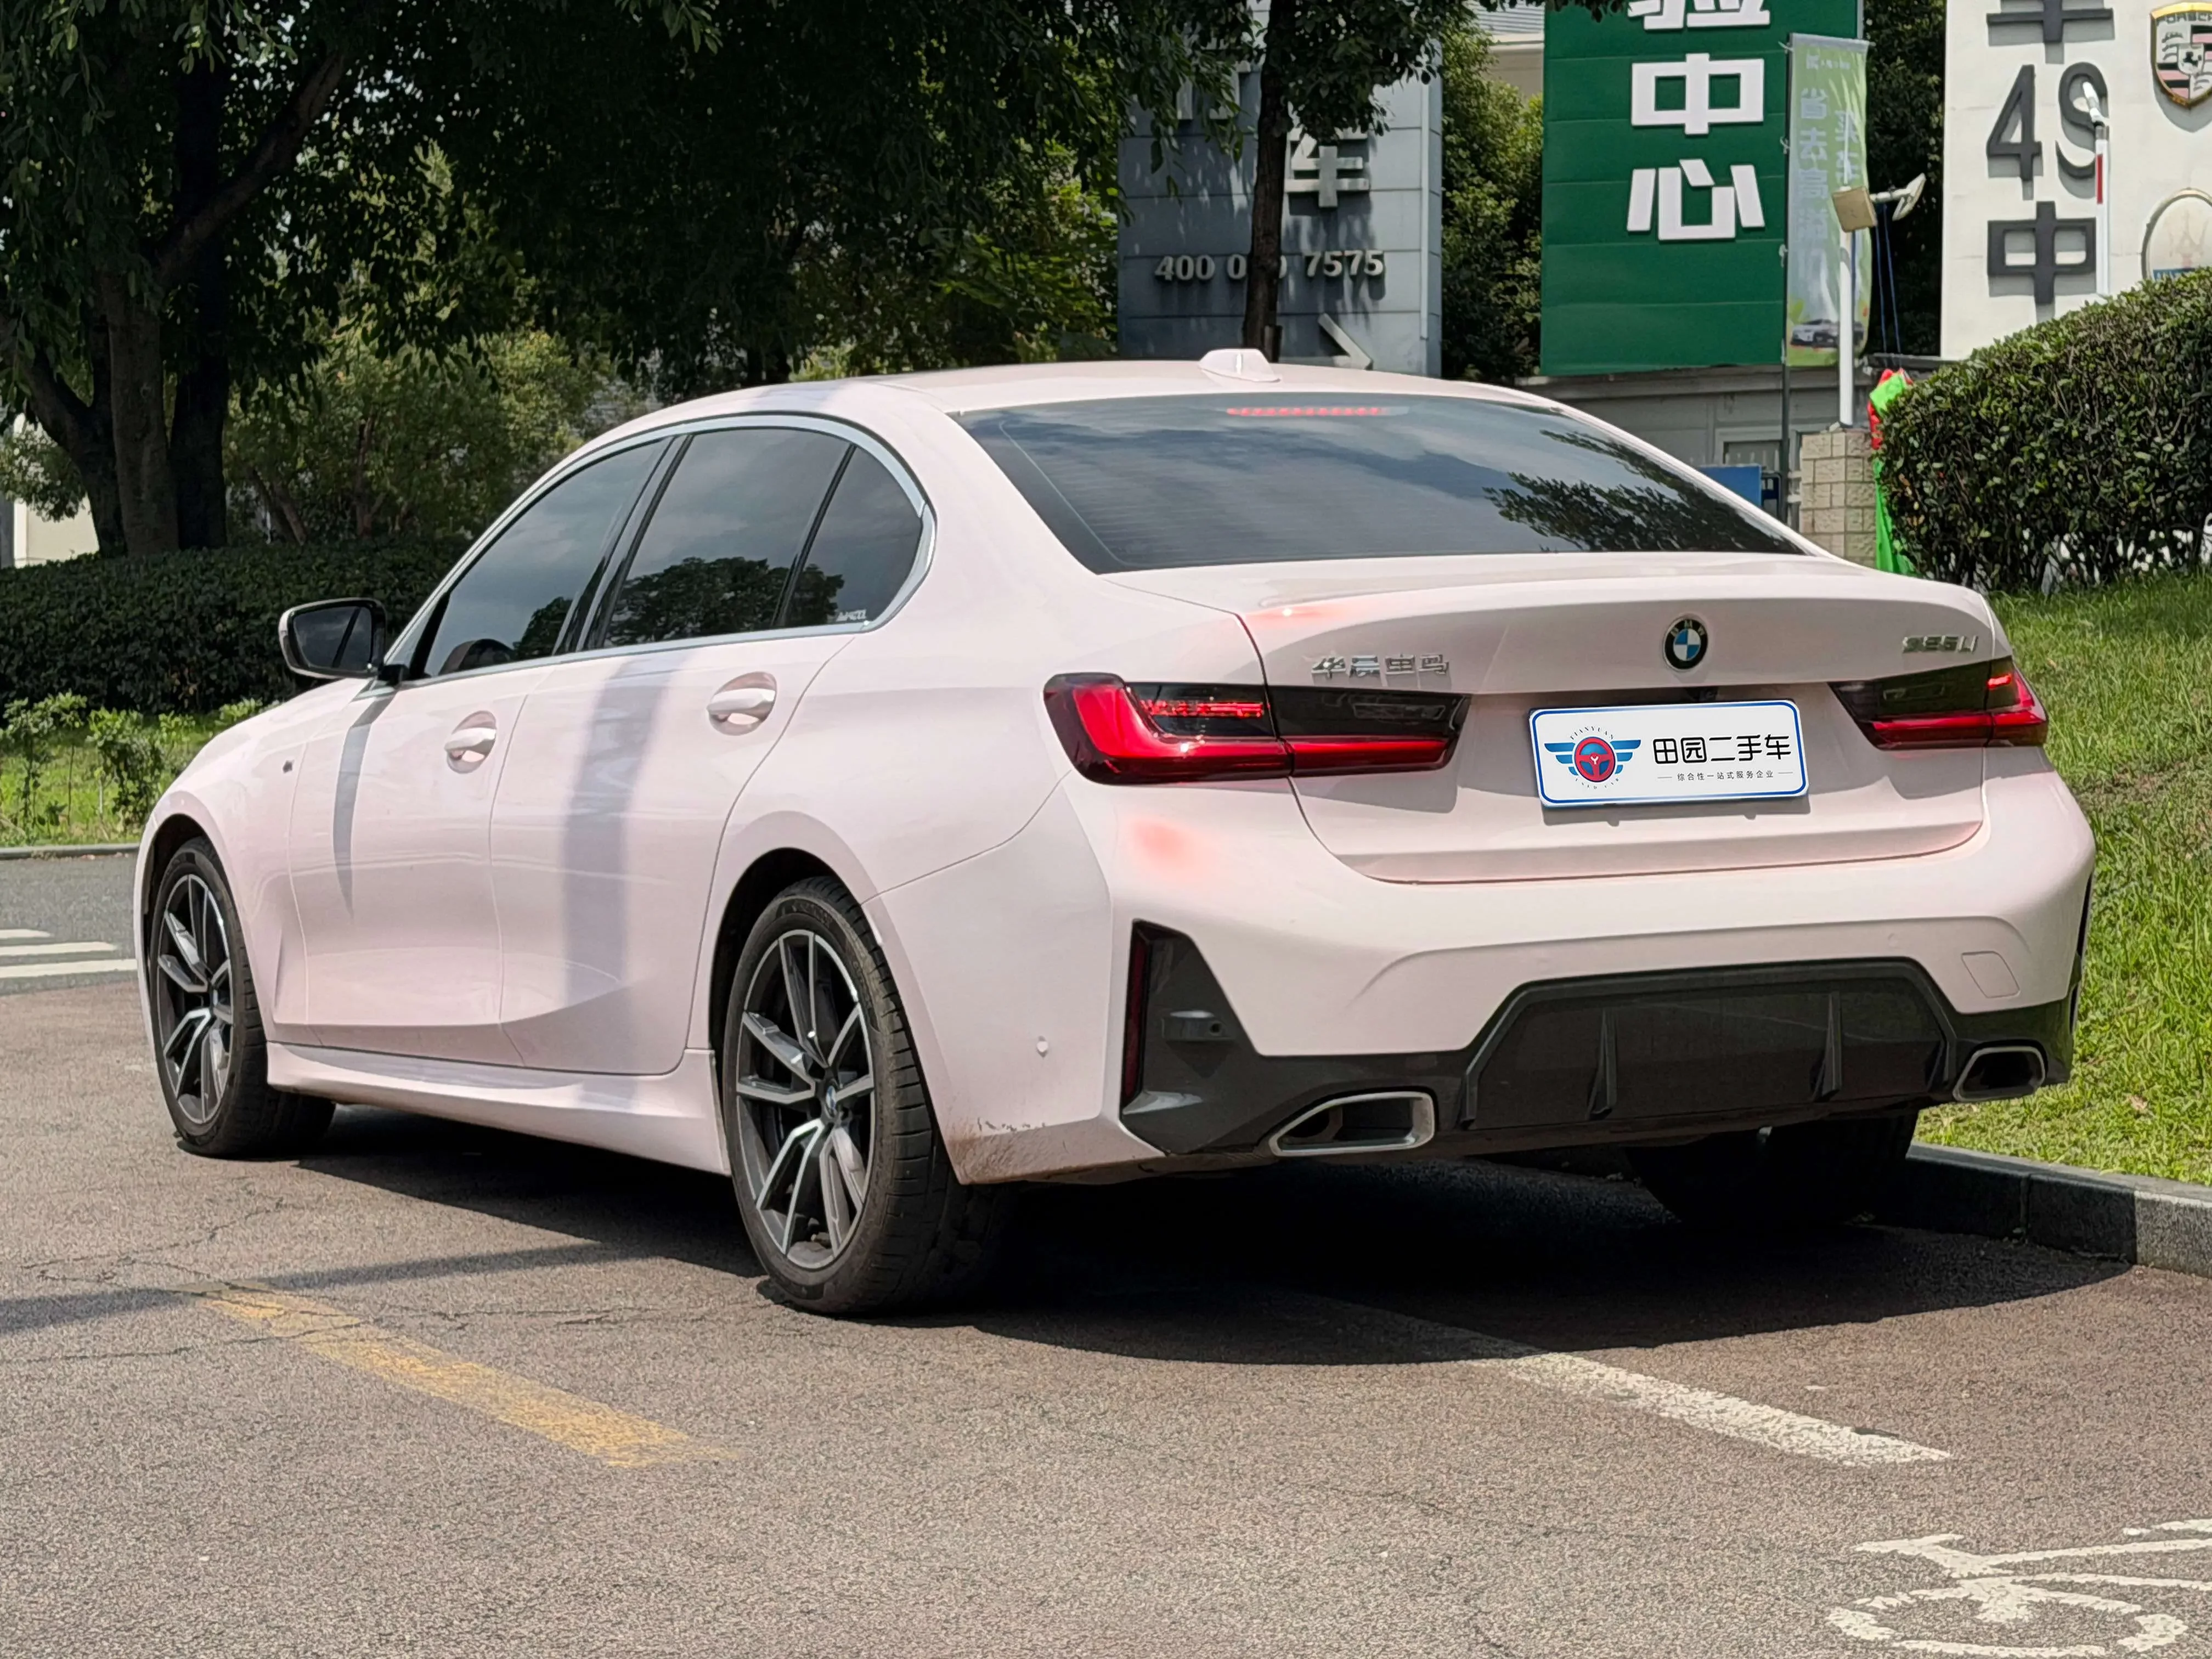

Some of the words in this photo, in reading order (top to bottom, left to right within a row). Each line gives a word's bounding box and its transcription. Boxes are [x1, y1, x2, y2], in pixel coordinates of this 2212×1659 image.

[1155, 255, 1215, 281] 400
[1305, 250, 1384, 277] 7575
[1653, 734, 1791, 764] 田园二手车
[1677, 770, 1774, 781] 综合性一站式服务企业
